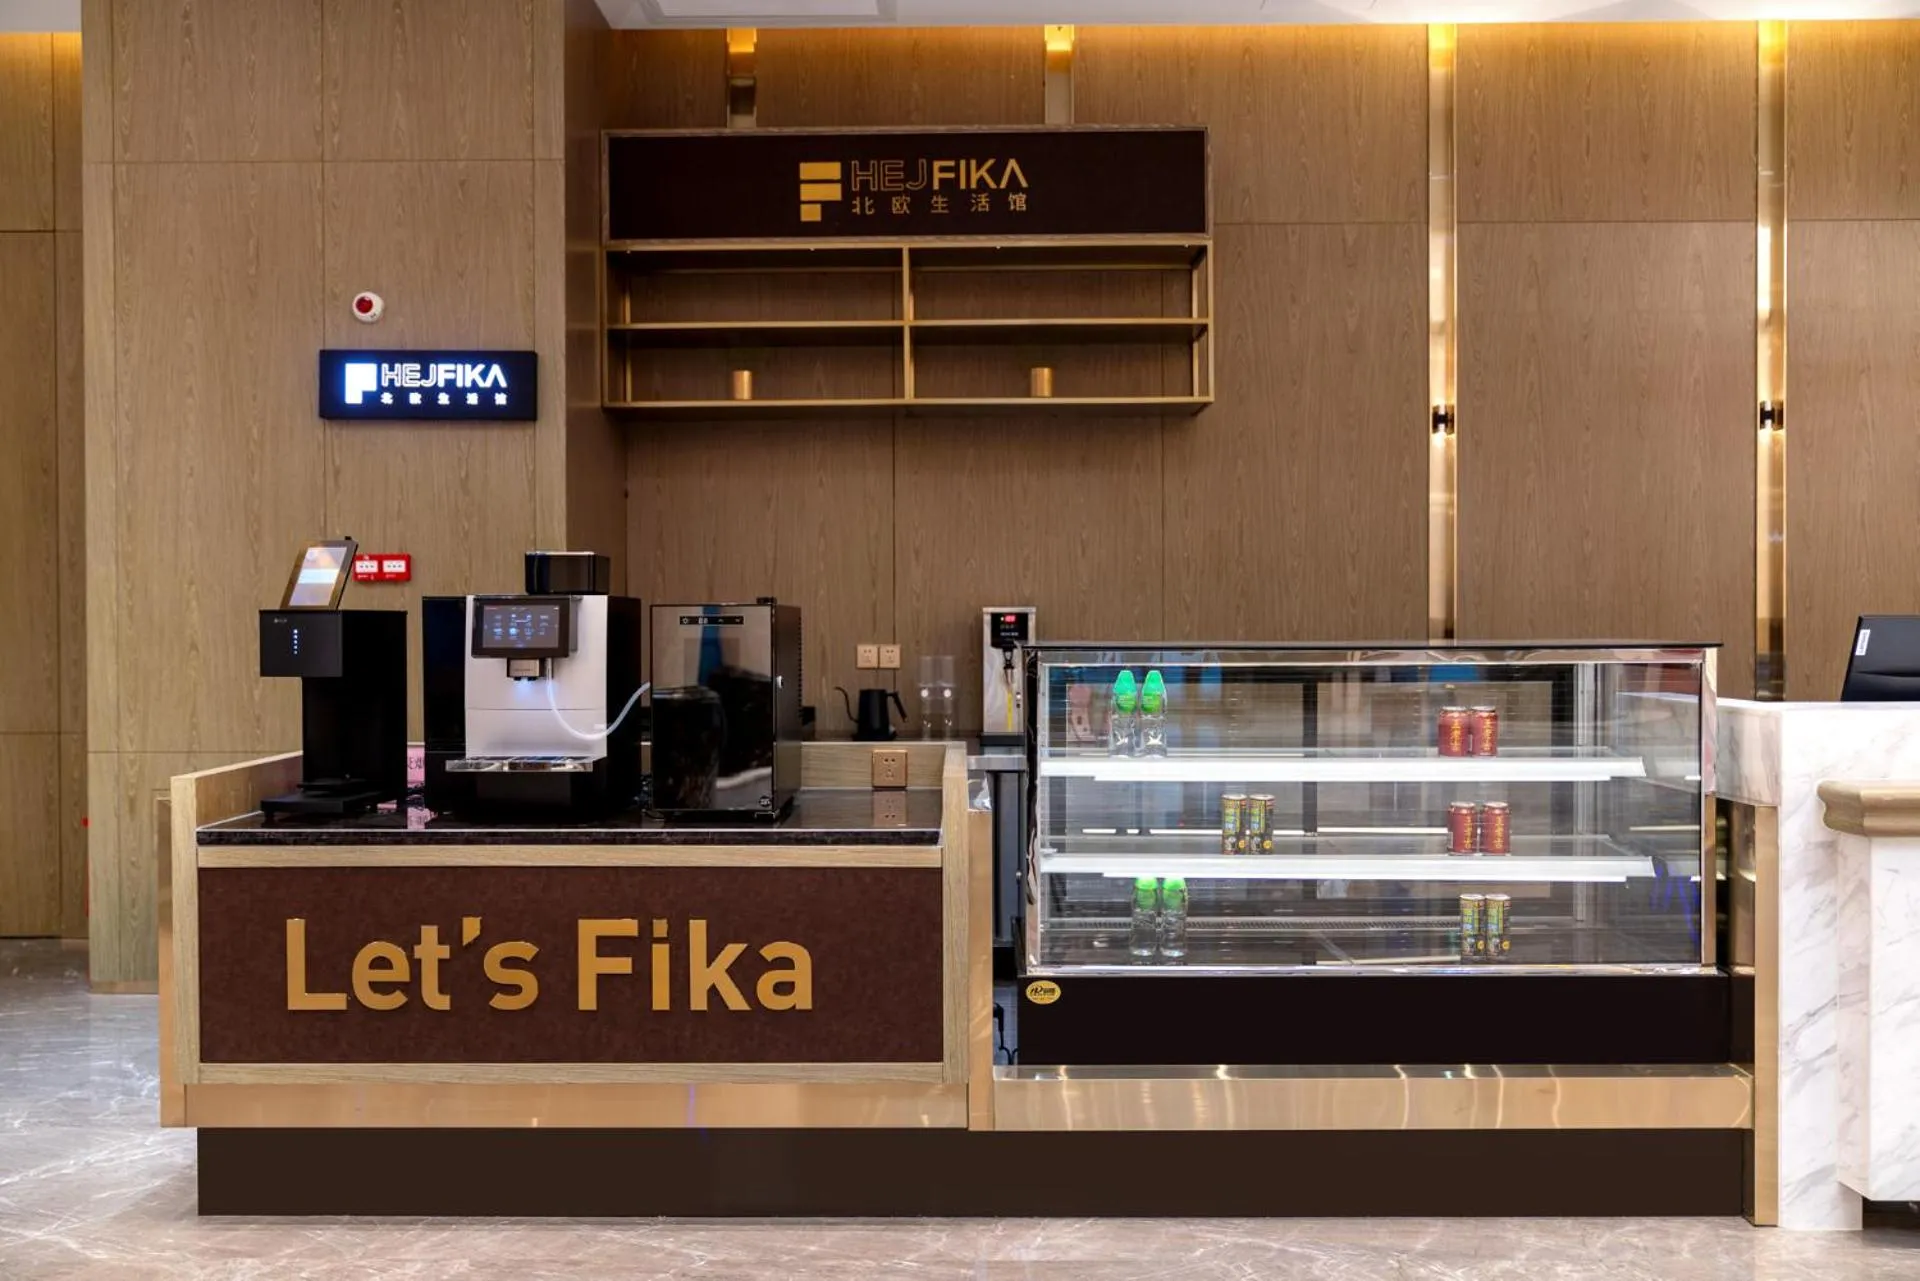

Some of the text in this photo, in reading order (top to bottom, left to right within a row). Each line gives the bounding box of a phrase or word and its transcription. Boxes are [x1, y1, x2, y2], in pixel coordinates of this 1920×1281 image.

[851, 158, 1029, 191] HEJFIKA
[851, 192, 1028, 215] 北欧生活馆
[380, 363, 508, 388] HEJFIKA
[286, 916, 813, 1011] Let's Fika
